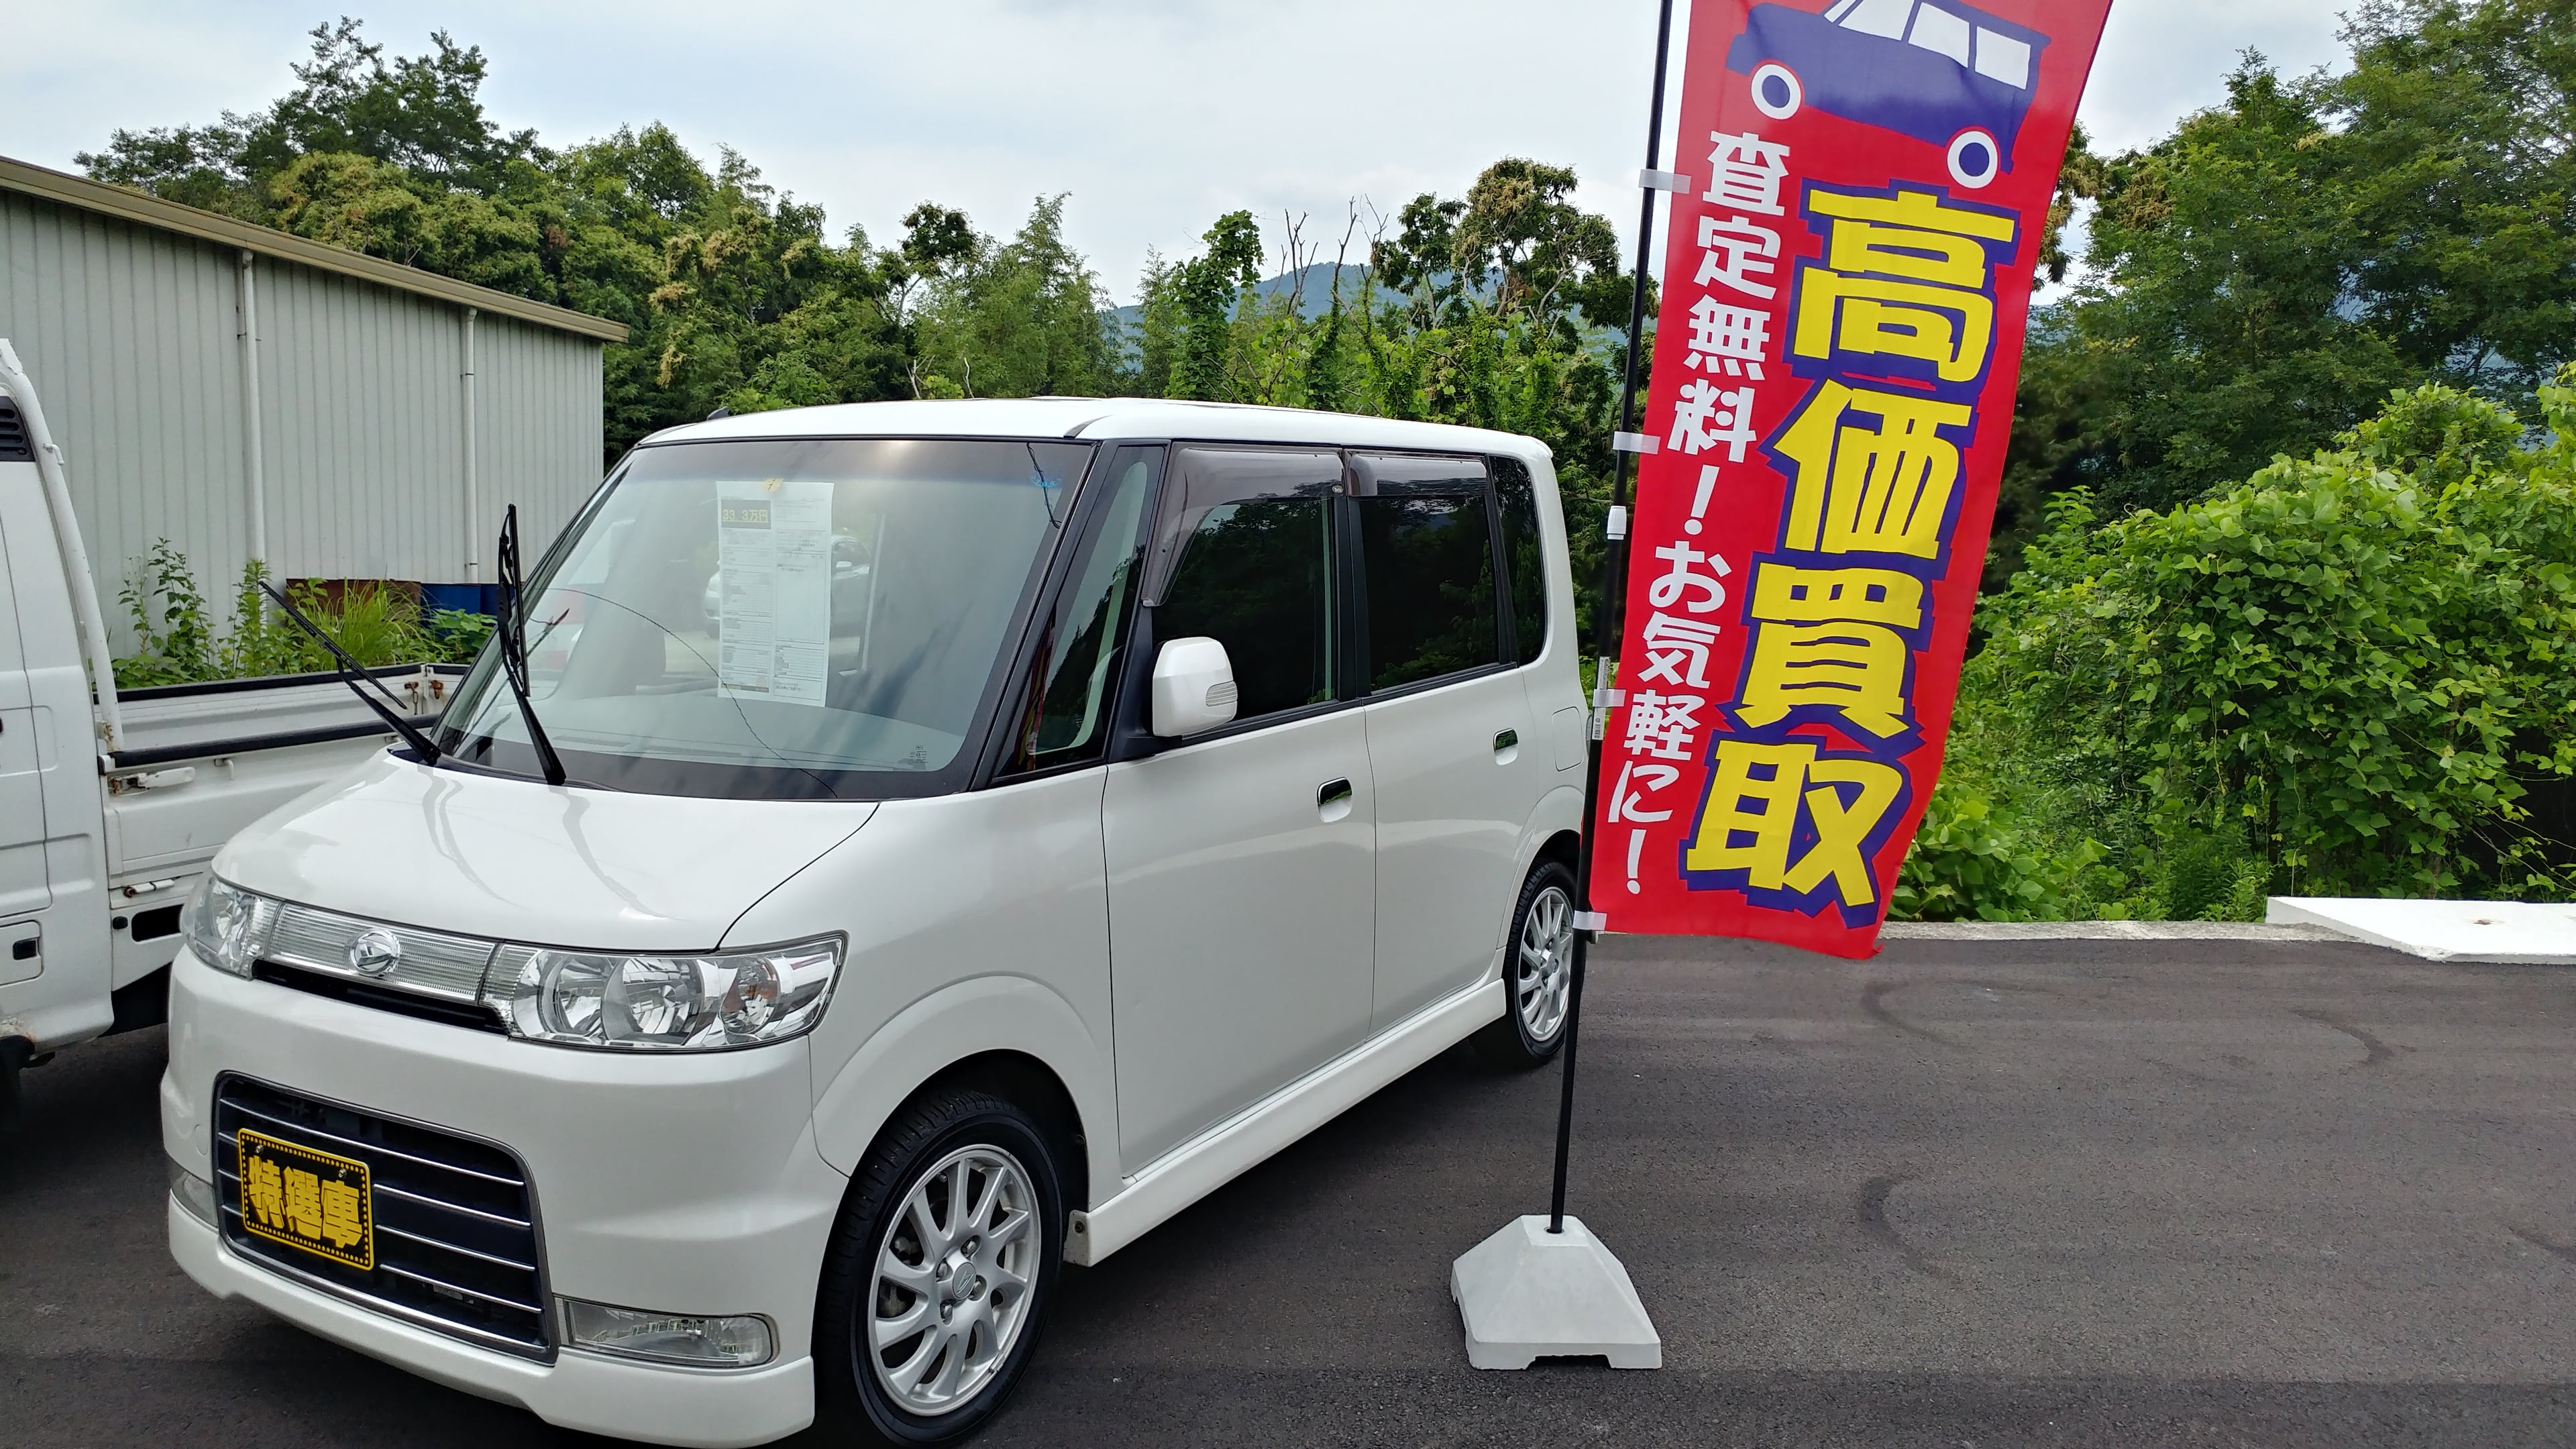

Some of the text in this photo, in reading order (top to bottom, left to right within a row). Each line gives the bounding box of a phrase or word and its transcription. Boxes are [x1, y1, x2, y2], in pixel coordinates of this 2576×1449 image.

[1686, 189, 2015, 907] 高価買取
[248, 1155, 363, 1248] 特選車
